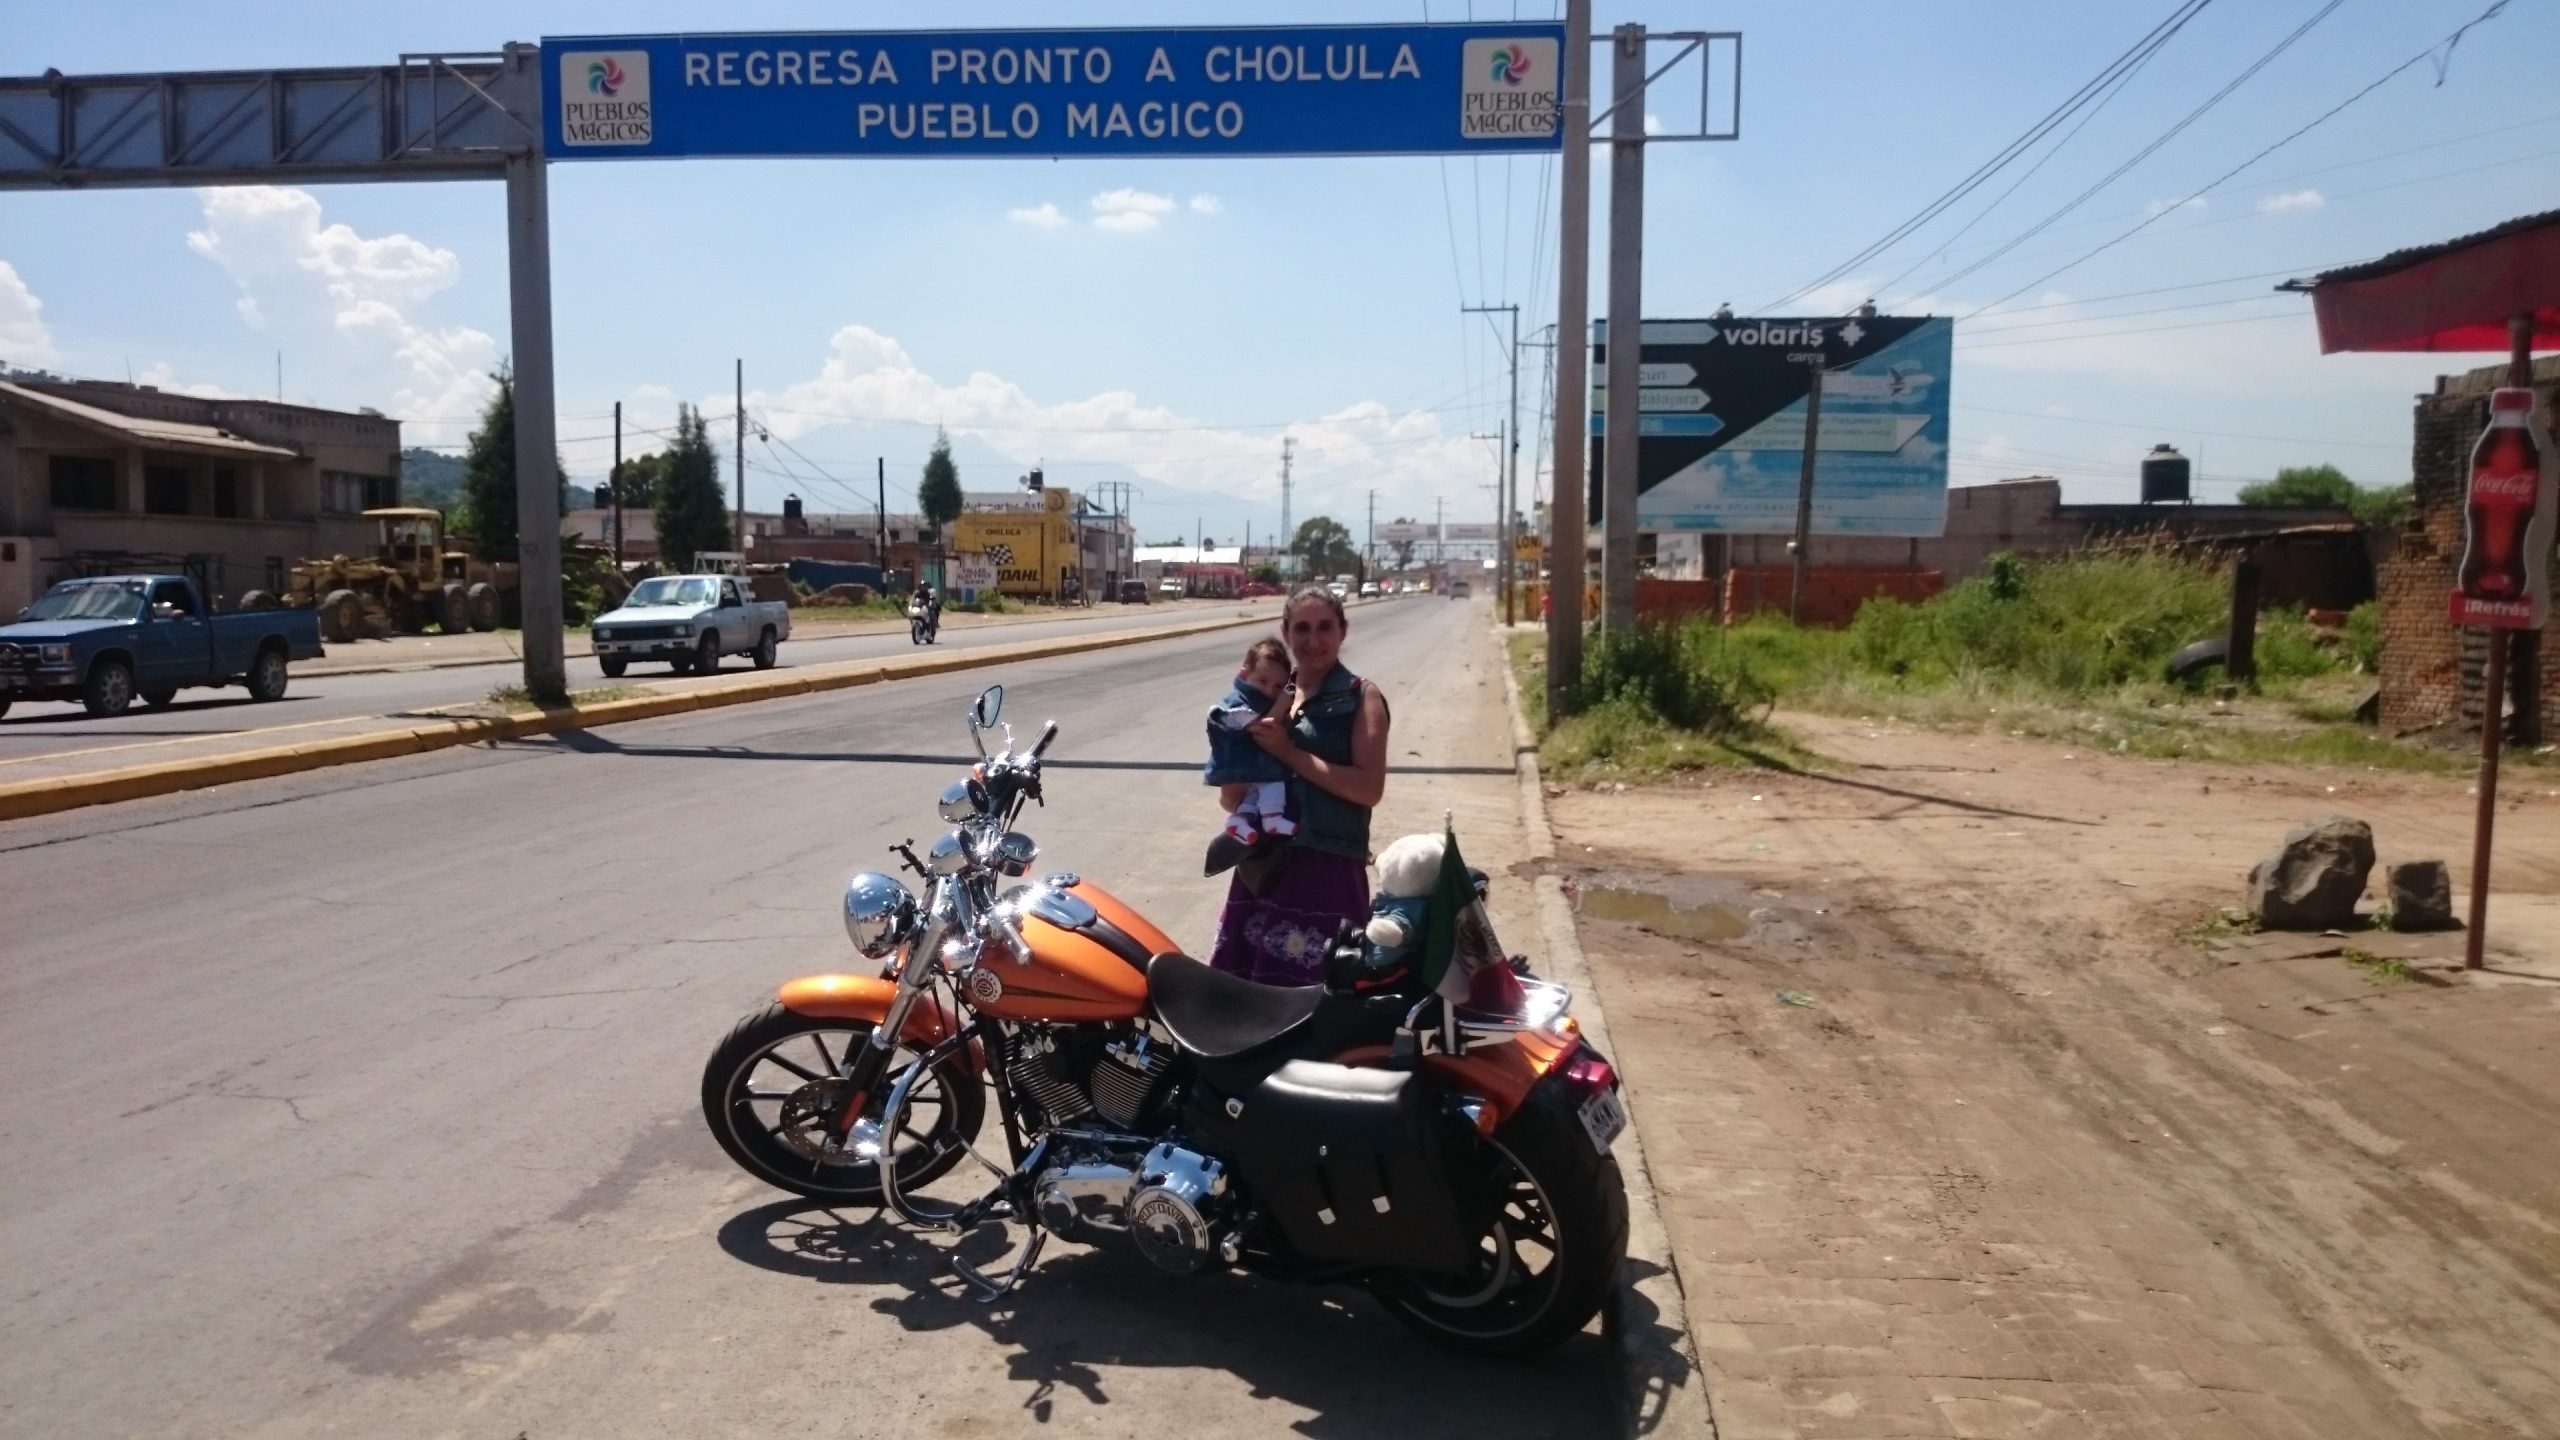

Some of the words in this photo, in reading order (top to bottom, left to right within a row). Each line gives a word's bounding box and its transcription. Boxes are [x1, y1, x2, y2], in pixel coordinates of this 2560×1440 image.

[685, 49, 899, 87] REGRESA
[930, 47, 1112, 85] PRONTO
[1145, 47, 1176, 83] A
[1205, 44, 1421, 82] CHOLULA
[858, 103, 1039, 139] PUEBLO
[1067, 101, 1244, 138] MAGICO
[1722, 320, 1825, 348] volaris
